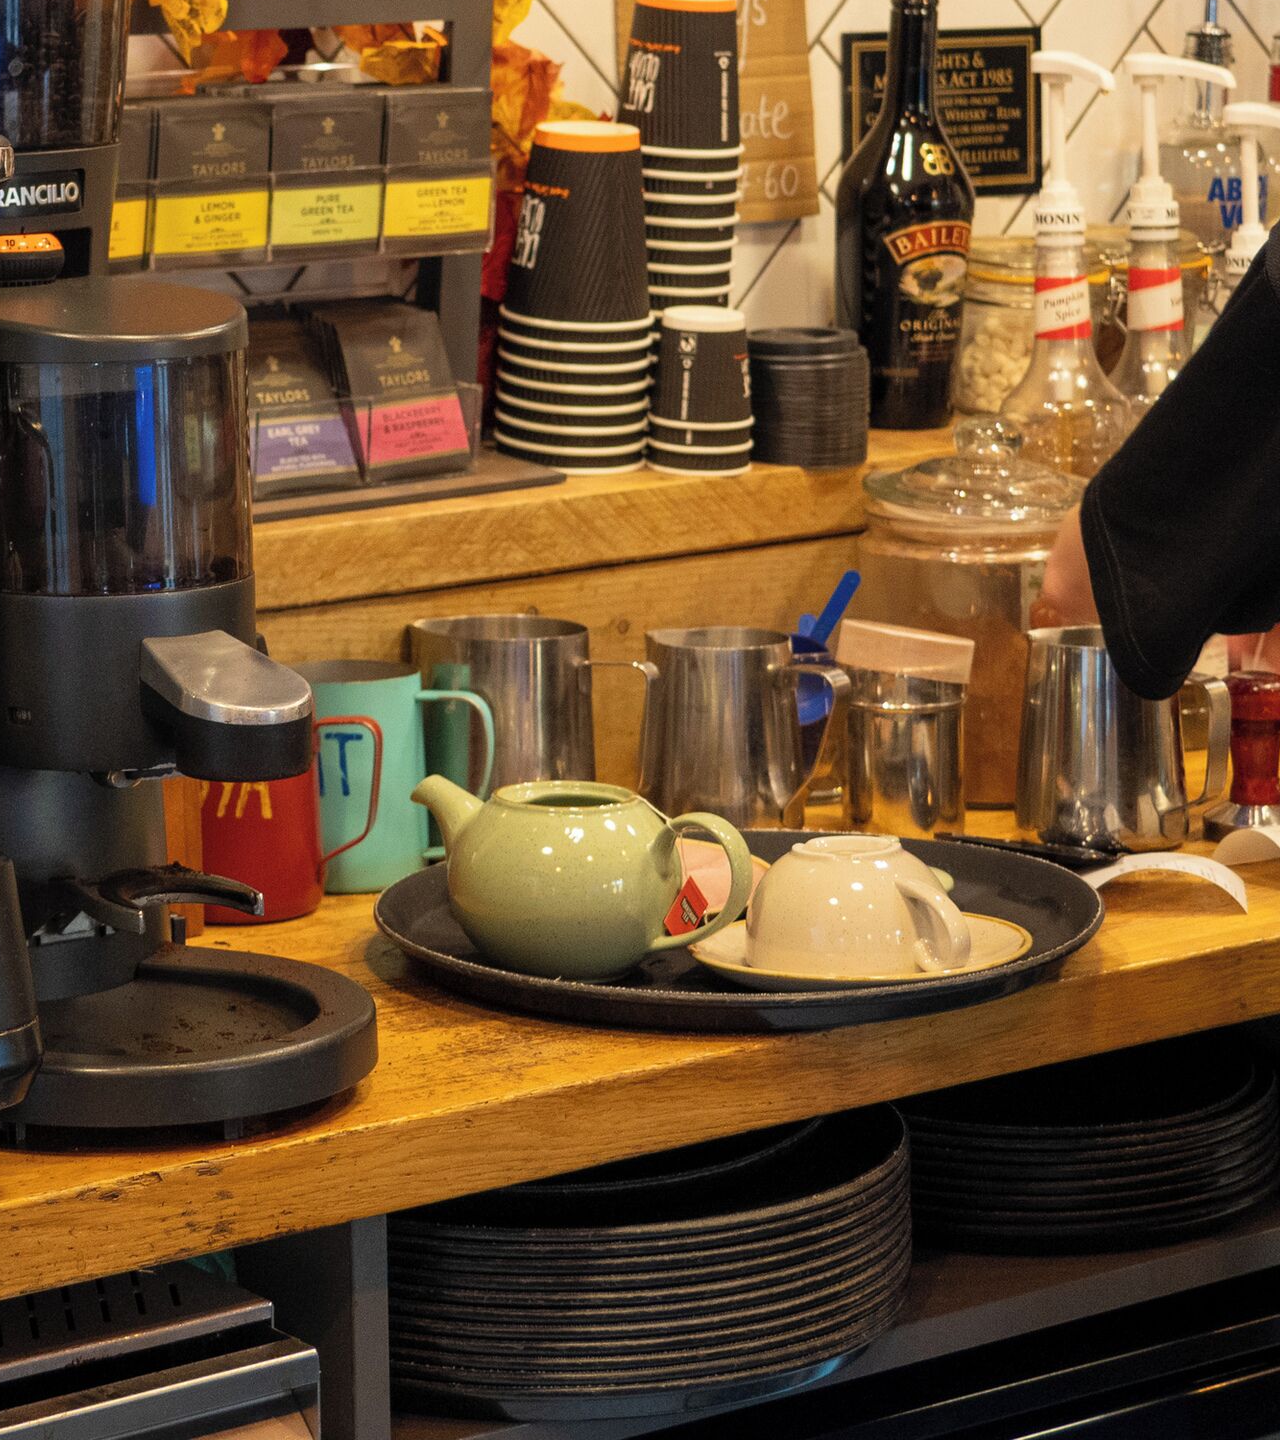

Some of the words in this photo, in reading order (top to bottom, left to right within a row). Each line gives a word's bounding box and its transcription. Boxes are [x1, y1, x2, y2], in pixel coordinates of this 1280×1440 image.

[948, 71, 977, 88] ACT
[316, 193, 341, 204] PURE
[417, 187, 448, 199] GREEN
[452, 185, 468, 196] TEA
[201, 201, 236, 212] LEMON
[432, 197, 466, 208] LEMON
[301, 205, 334, 217] GREEN
[336, 204, 355, 214] TEA
[204, 212, 240, 224] GINGER
[5, 238, 16, 248] 10
[1043, 289, 1086, 310] Pumpkin
[1055, 307, 1082, 323] Spice
[379, 369, 431, 388] TAYLORS
[256, 389, 311, 405] TAYLORS
[267, 426, 294, 439] EARL
[297, 424, 321, 437] GREY
[288, 436, 308, 448] TEA
